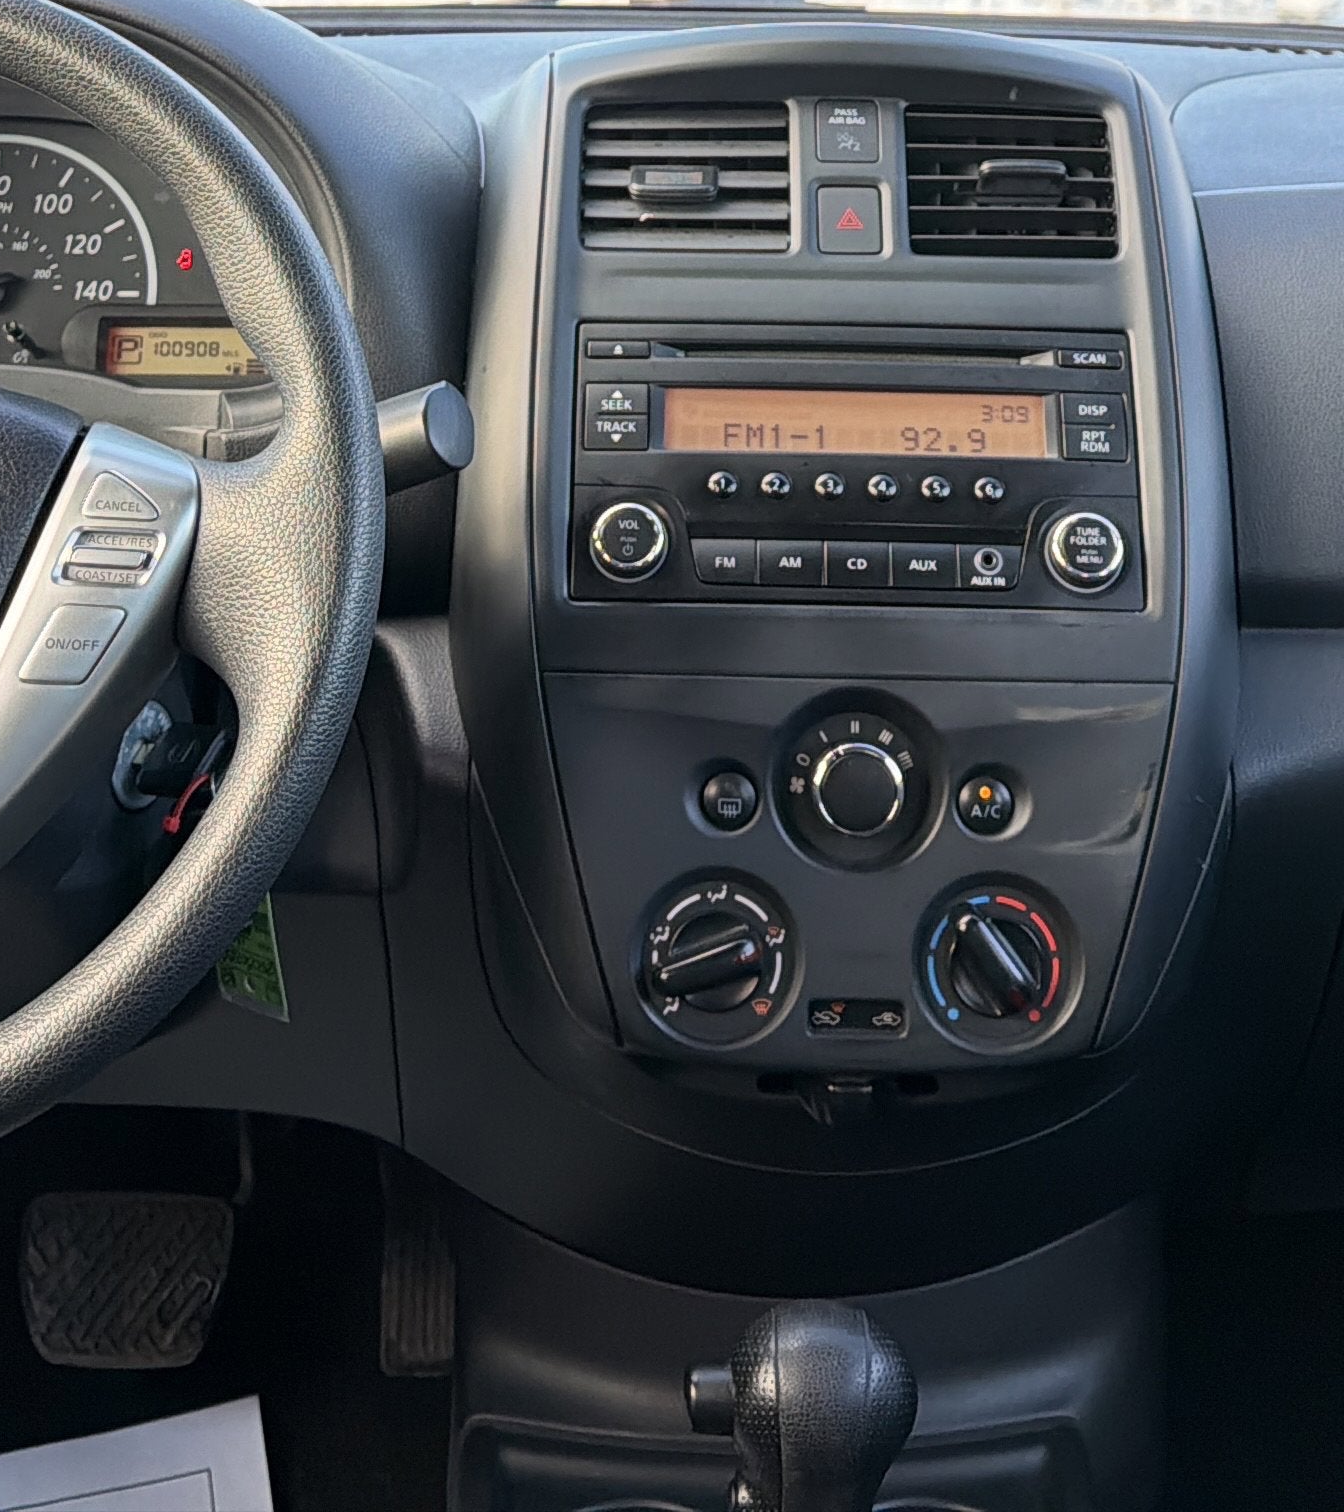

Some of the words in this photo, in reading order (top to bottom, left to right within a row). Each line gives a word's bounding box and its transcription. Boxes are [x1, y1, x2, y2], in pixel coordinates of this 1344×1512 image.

[833, 108, 859, 117] PASS
[828, 116, 845, 125] AIR
[846, 116, 866, 125] BAG
[33, 193, 74, 215] 100
[63, 234, 102, 255] 120
[74, 280, 114, 301] 140
[117, 338, 139, 360] P
[153, 340, 221, 358] 100908
[1072, 353, 1107, 365] SCAN
[601, 399, 633, 411] SEEK
[1078, 405, 1108, 416] DISP
[981, 404, 1030, 424] 3:09
[596, 421, 637, 433] TRACK
[723, 423, 824, 449] FM1-1
[900, 427, 986, 454] 92.9
[1082, 431, 1105, 442] RPT
[1080, 442, 1110, 453] RDM
[95, 500, 142, 514] CANCEL
[618, 519, 640, 531] VOL
[1076, 526, 1101, 536] TUNE
[87, 534, 153, 548] ACCEL/RES
[1069, 535, 1107, 546] FOLDER
[715, 557, 736, 568] FM
[778, 557, 802, 568] AM
[847, 558, 868, 570] CD
[909, 559, 938, 572] AUX
[75, 569, 140, 583] COAST/SET
[970, 575, 992, 586] AUX
[993, 576, 1006, 586] IN
[45, 638, 100, 651] ON/OFF
[970, 804, 1001, 819] A/C
